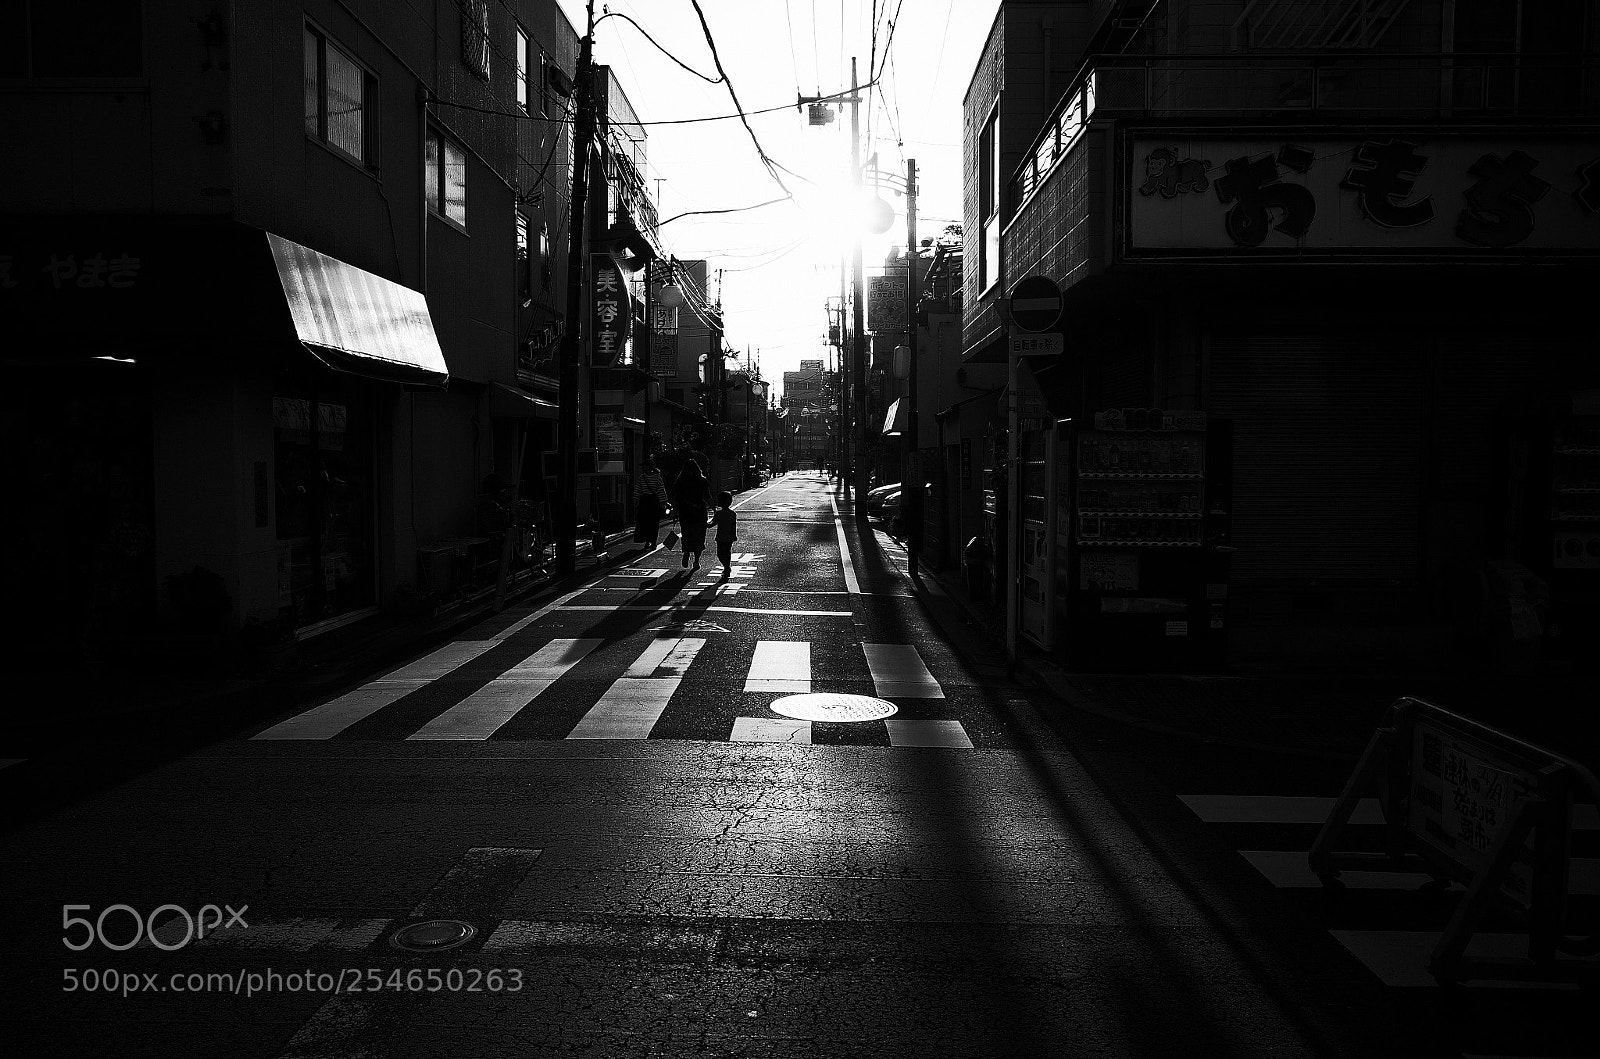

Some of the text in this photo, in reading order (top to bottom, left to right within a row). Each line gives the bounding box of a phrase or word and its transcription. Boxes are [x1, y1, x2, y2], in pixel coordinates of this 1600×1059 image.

[1214, 138, 1600, 247] おもち
[40, 252, 143, 289] やまき
[1013, 338, 1058, 351] 自転車を除く
